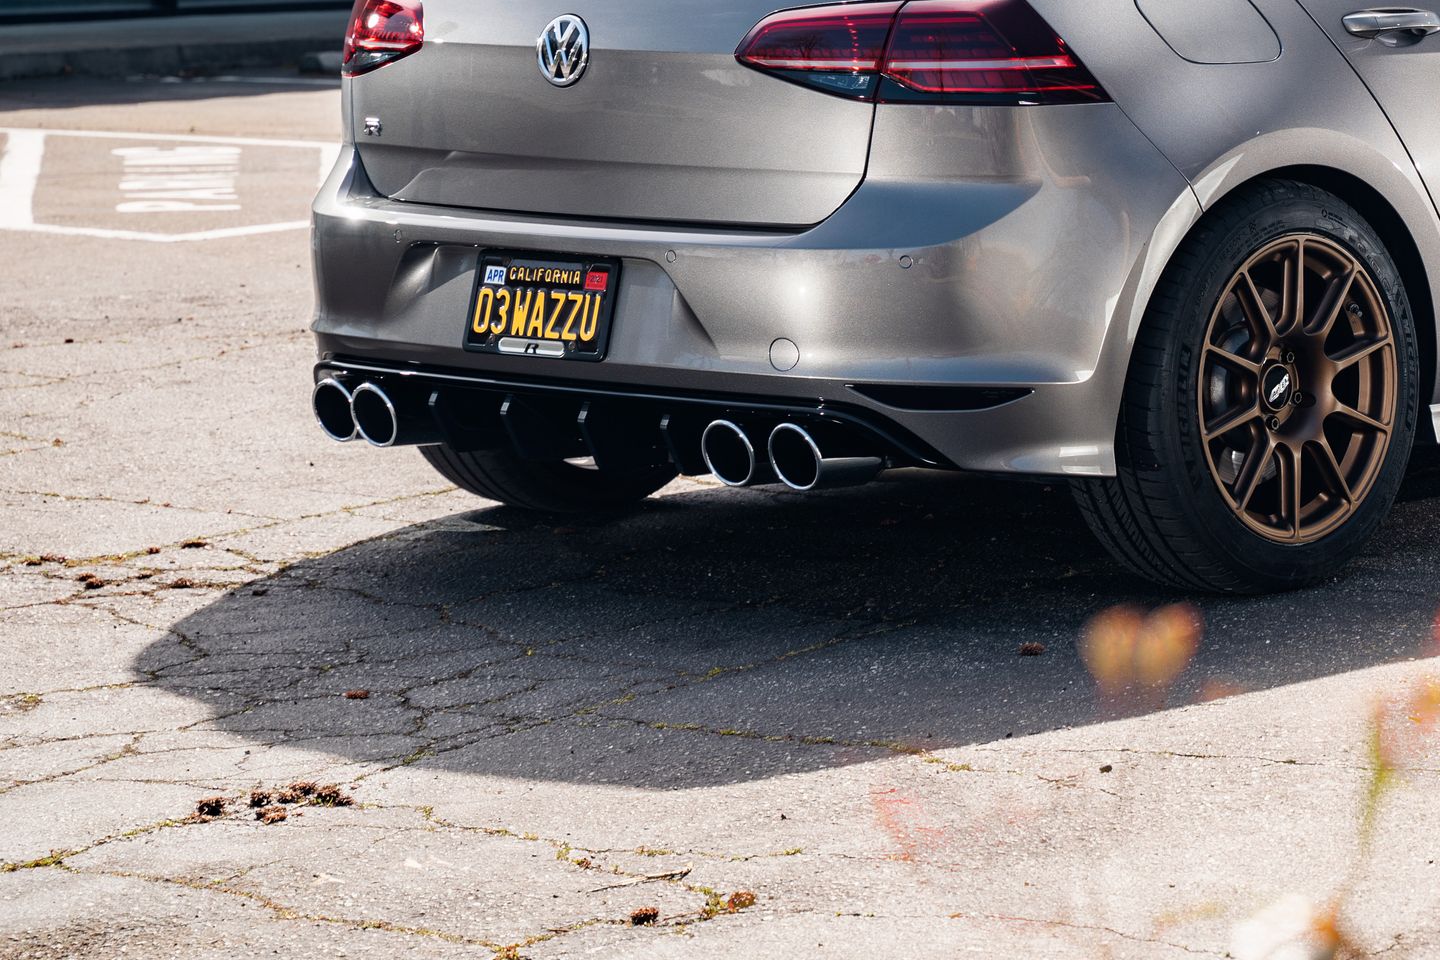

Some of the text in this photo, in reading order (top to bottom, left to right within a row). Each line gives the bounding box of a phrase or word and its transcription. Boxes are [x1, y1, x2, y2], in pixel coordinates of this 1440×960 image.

[486, 269, 505, 282] APR
[510, 266, 581, 285] CALIFORNIA
[524, 343, 539, 354] R
